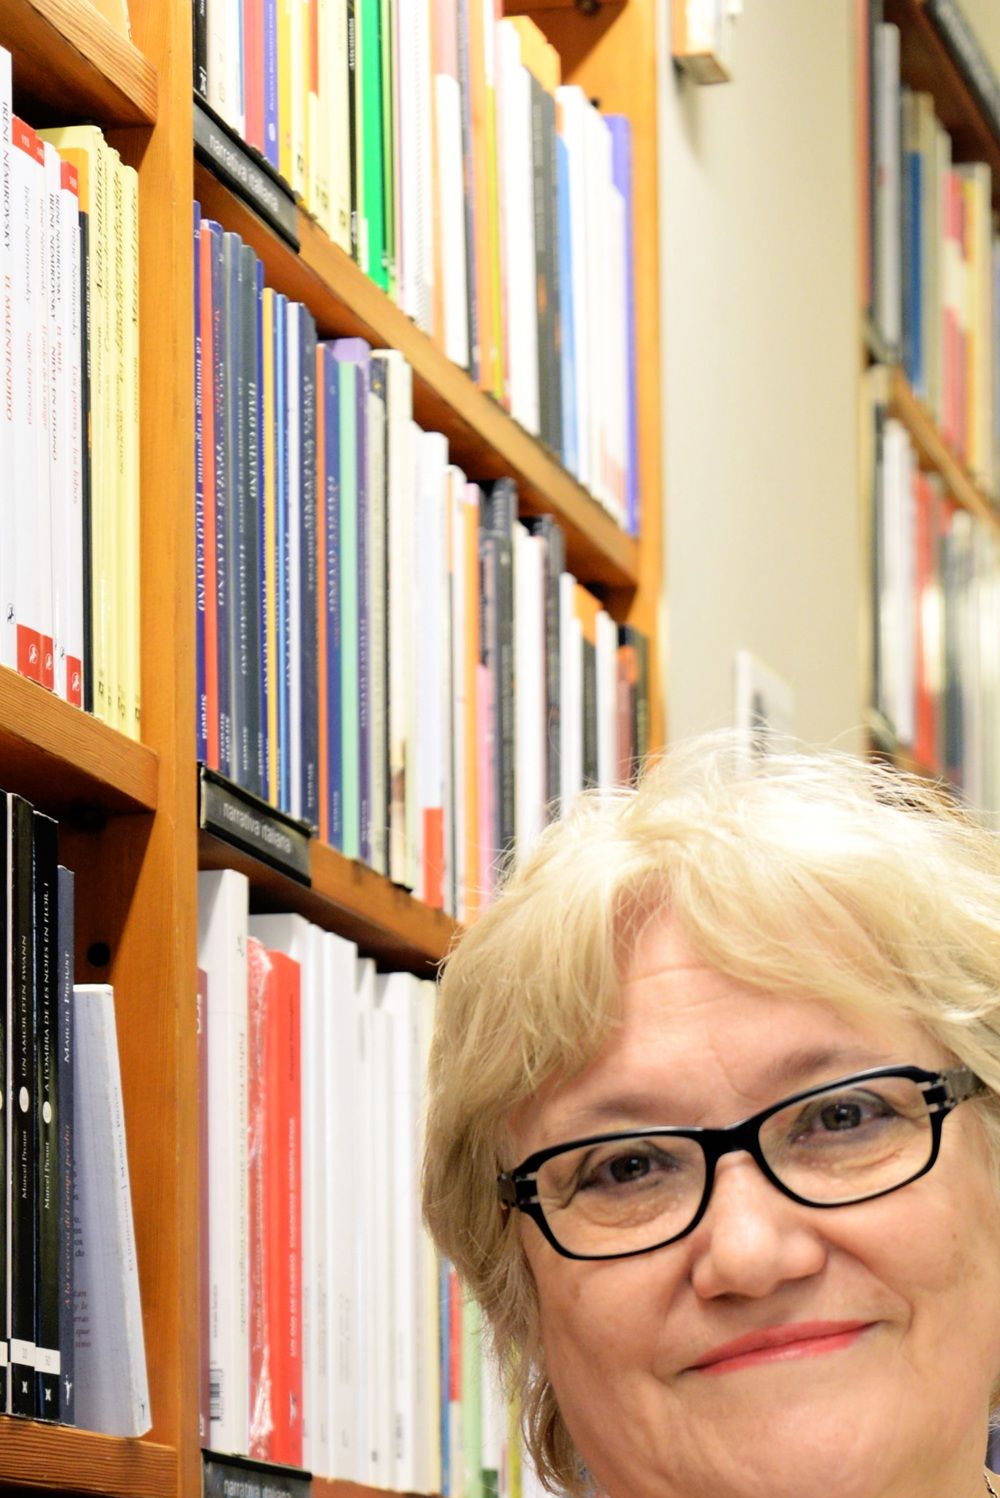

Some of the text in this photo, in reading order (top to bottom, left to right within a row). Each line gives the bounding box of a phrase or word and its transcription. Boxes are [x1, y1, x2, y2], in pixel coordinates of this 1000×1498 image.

[208, 133, 249, 182] narrativa
[94, 148, 103, 298] Ácido sulfúrico
[4, 295, 13, 422] MALENTENDIDO
[51, 388, 57, 405] EN
[248, 382, 258, 428] ITALO
[249, 431, 259, 497] CALVINO
[194, 336, 208, 740] La hormiga argentina ITALO CALVINO Siruela
[222, 801, 292, 855] narrativa italiana
[43, 926, 50, 943] EN
[20, 985, 28, 1013] D'EN
[43, 1009, 50, 1025] DE
[21, 1055, 27, 1077] UN
[63, 1123, 72, 1167] perdut
[288, 1116, 297, 1191] COMPLETOS
[63, 1168, 72, 1207] temps
[63, 1208, 71, 1229] del
[288, 1192, 297, 1248] CUENTOS
[63, 1282, 71, 1295] la
[288, 1298, 297, 1315] DE
[288, 1338, 297, 1358] UN
